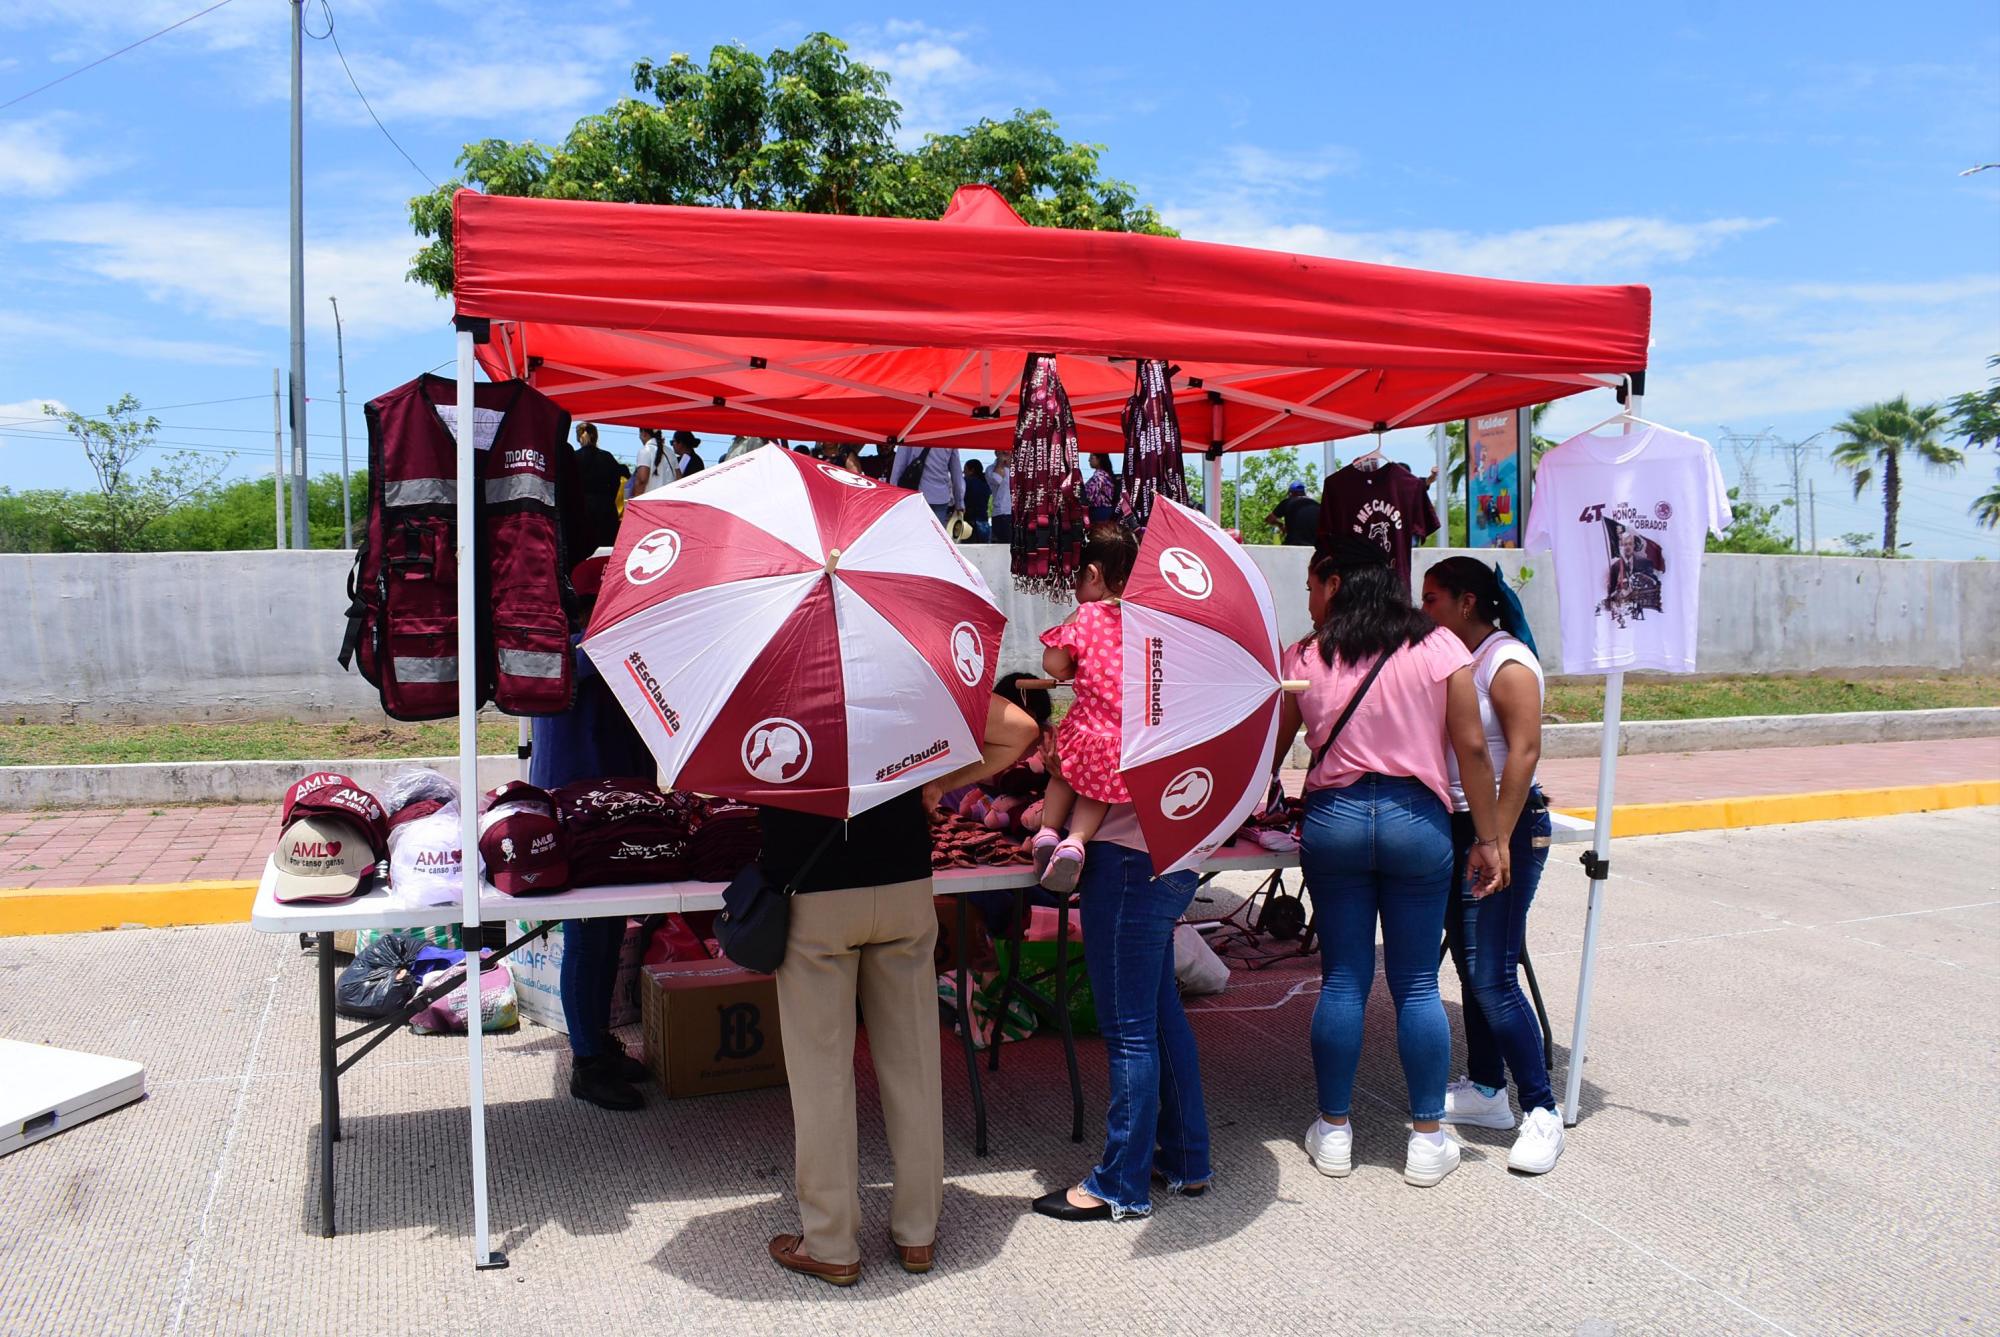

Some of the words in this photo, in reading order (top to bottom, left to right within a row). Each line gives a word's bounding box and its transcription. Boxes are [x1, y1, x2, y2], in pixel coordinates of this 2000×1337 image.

[505, 449, 546, 466] morena
[1071, 437, 1079, 468] MÉXICO
[1579, 504, 1606, 523] 4T
[1612, 509, 1637, 520] HONOR
[1634, 520, 1668, 531] OBRADOR
[1151, 637, 1163, 727] #EsClaudia
[628, 651, 681, 733] #EsClaudia
[875, 738, 950, 781] #EsClaudia
[302, 860, 322, 868] canso
[325, 859, 345, 869] ganso
[428, 867, 449, 875] canso
